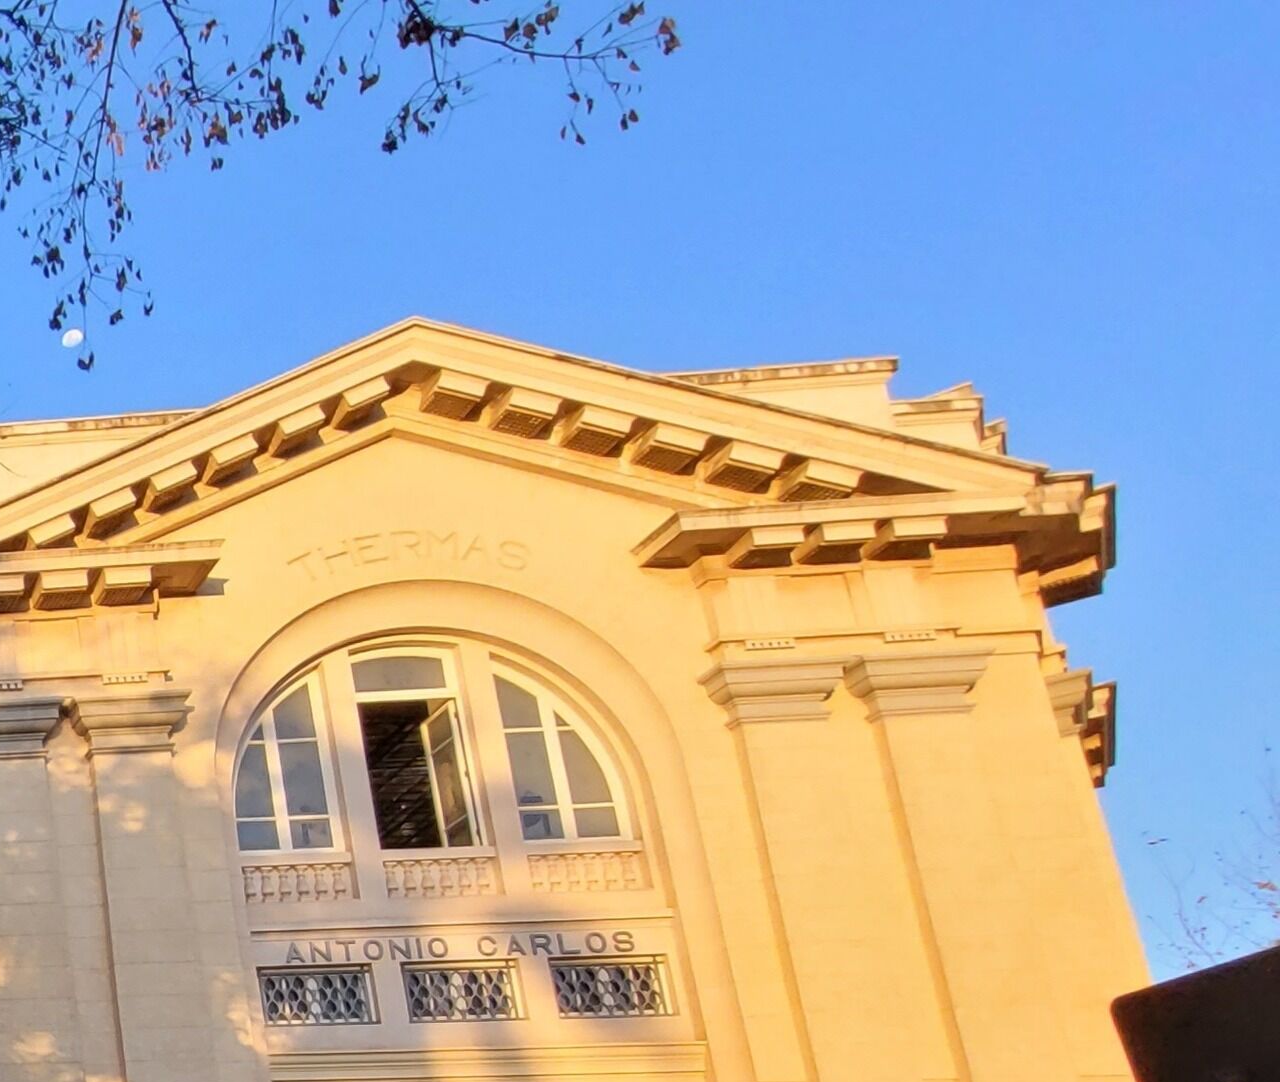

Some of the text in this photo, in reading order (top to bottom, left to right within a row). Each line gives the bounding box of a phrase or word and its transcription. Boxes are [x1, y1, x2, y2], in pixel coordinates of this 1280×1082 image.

[287, 529, 532, 582] THERMAS
[286, 931, 635, 964] ANTONIO CARLOS
